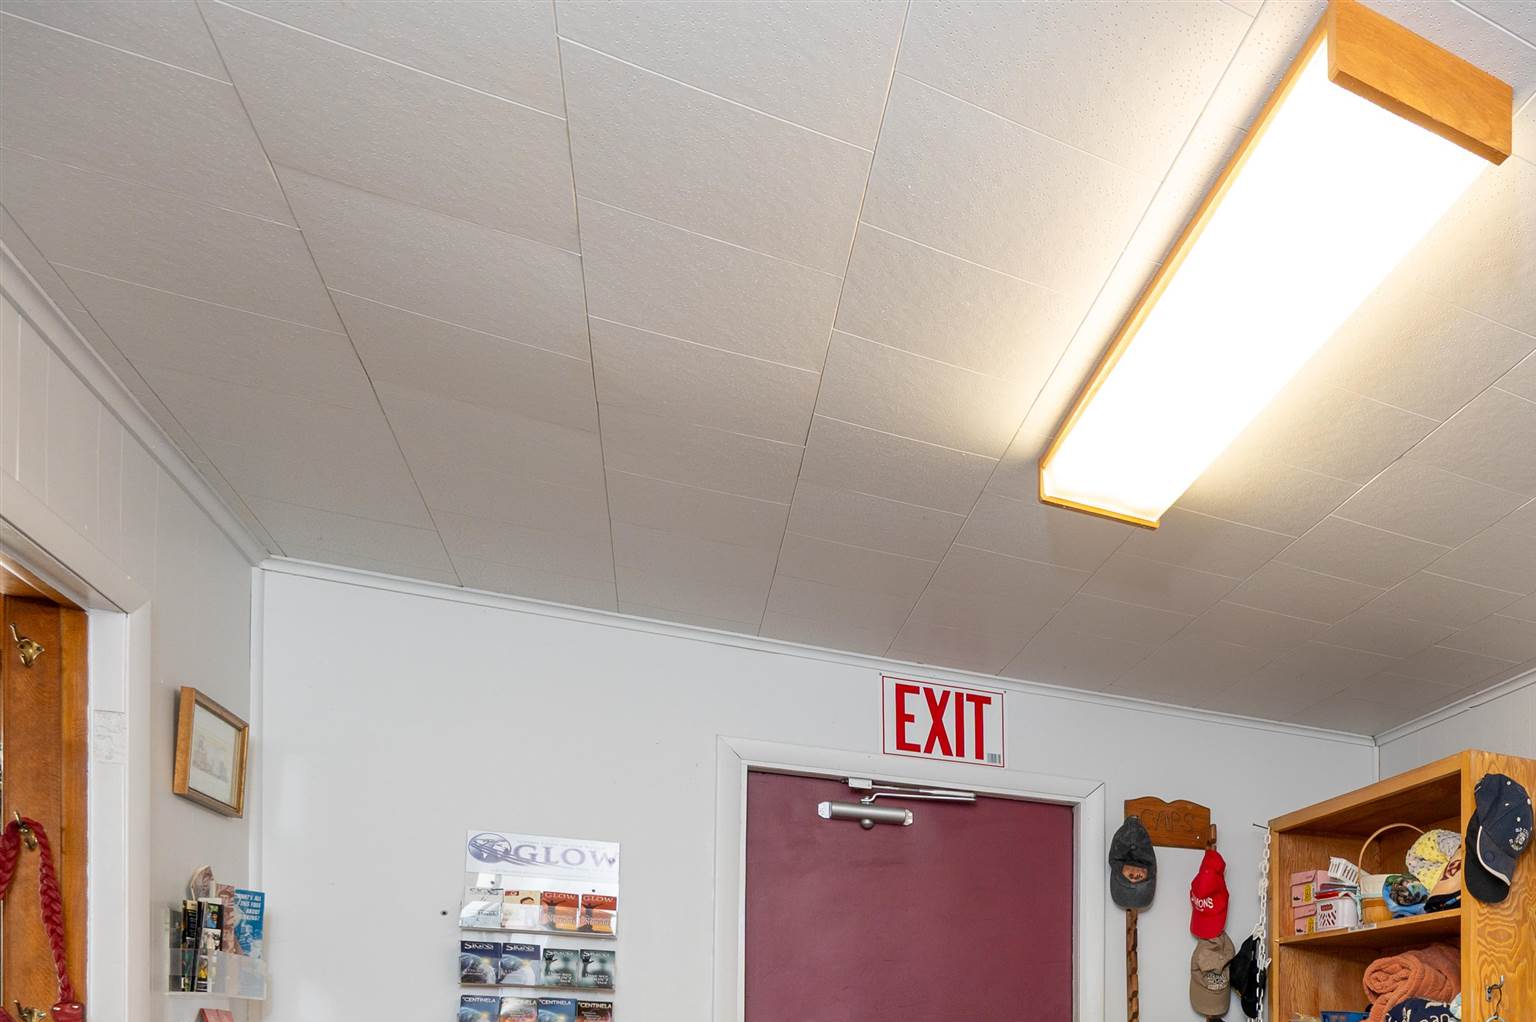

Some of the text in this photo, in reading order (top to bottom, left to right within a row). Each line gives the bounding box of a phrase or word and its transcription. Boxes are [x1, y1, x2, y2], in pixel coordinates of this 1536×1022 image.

[895, 683, 992, 760] EXIT
[1141, 809, 1195, 832] CAPS
[513, 844, 616, 867] GLOW
[583, 895, 614, 903] GLOW
